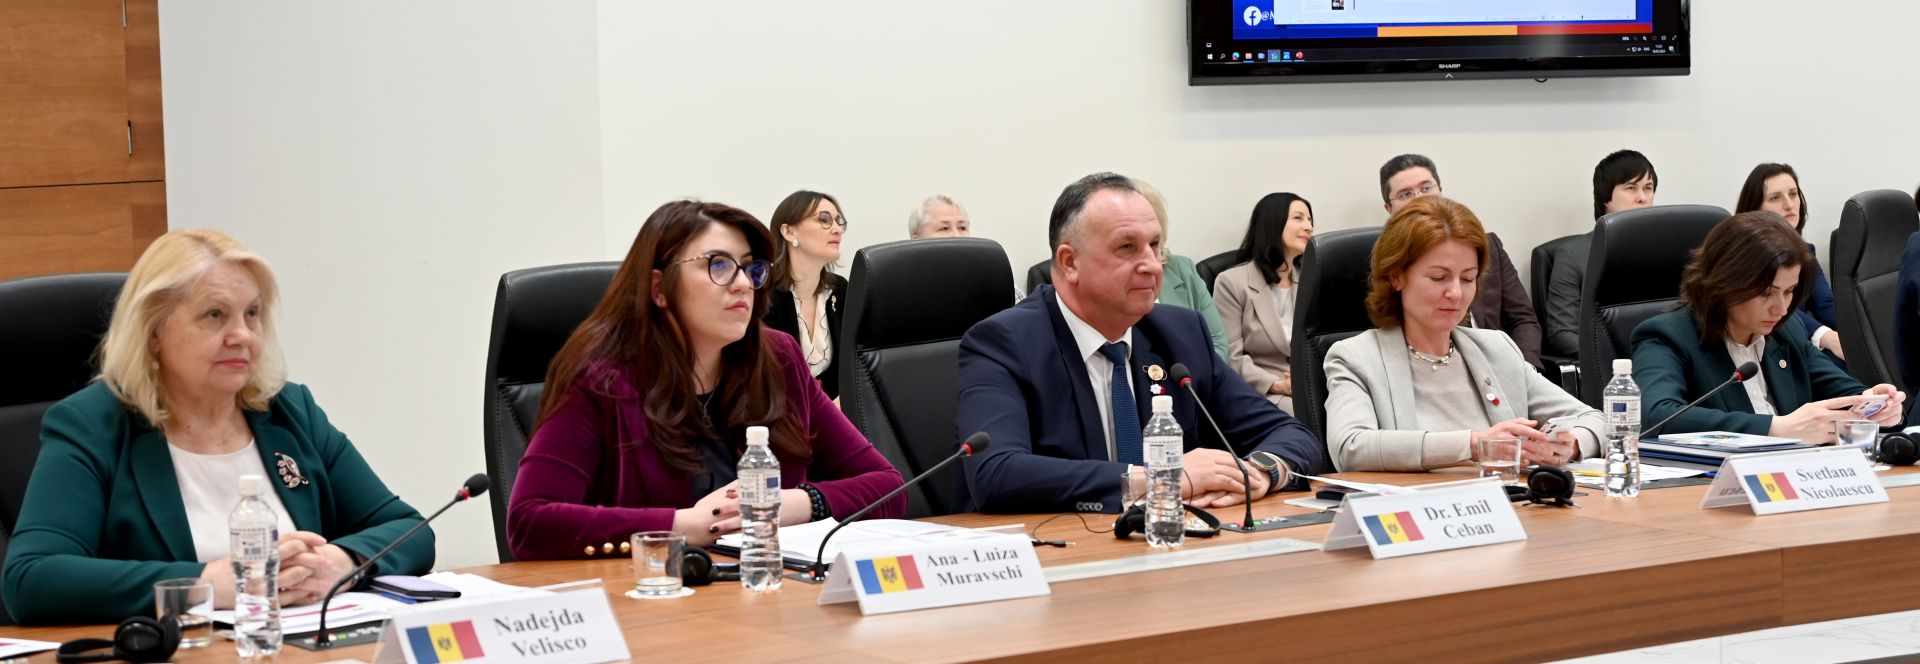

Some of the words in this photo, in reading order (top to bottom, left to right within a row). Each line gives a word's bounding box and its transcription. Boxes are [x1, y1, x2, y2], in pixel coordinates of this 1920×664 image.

[1795, 465, 1857, 482] Svetlana
[1800, 482, 1875, 501] Nicolaescu
[1424, 506, 1452, 521] Dr.
[1452, 499, 1493, 518] Emil
[1443, 522, 1496, 540] Ceban
[926, 554, 959, 568] Ana
[973, 547, 1019, 564] Luiza
[936, 565, 1024, 587] Muravschi
[493, 608, 585, 636] Nadejda
[511, 636, 587, 657] Velisco
